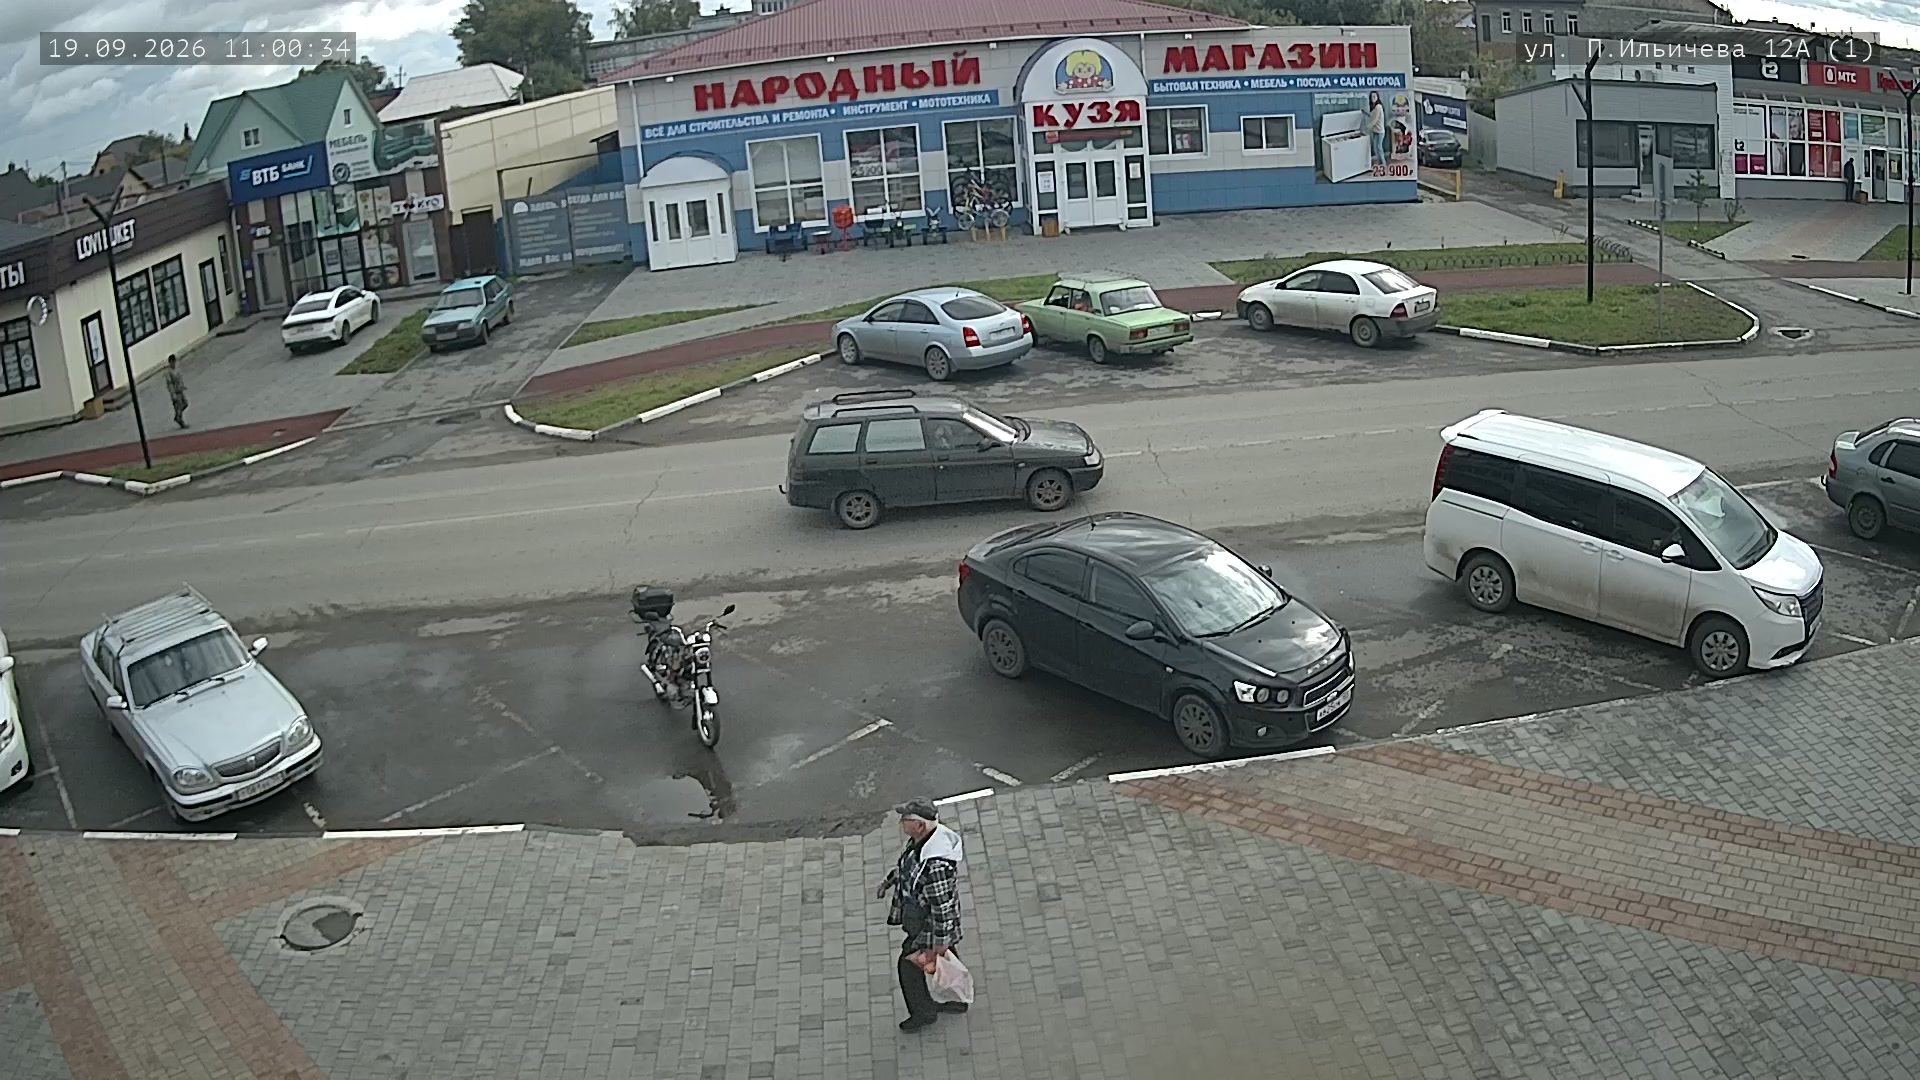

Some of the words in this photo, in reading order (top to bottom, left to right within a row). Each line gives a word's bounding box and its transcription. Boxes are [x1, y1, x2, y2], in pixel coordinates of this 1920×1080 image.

[1163, 42, 1378, 74] МАГАЗИН
[694, 50, 981, 112] НАРОДНЫЙ
[1250, 78, 1287, 89] МЕБЕЛЬ
[1296, 77, 1331, 89] ПОСУДА
[1340, 77, 1357, 88] САД
[1358, 76, 1365, 87] И
[1366, 75, 1401, 87] ОГОРОД
[1837, 70, 1857, 83] МТС
[1153, 79, 1198, 93] БЫТОВАЯ
[1200, 79, 1241, 91] ТЕХНИКА
[842, 100, 909, 116] ИНСТРУМЕНТ
[918, 93, 991, 109] МОТОТЕХНИКА
[667, 124, 687, 137] ДЛЯ
[689, 114, 770, 133] СТРОИТЕЛЬСТВА
[772, 113, 780, 124] И
[782, 108, 830, 123] РЕМОНТА
[1032, 100, 1141, 129] КУЗЯ
[251, 165, 280, 186] ВТБ
